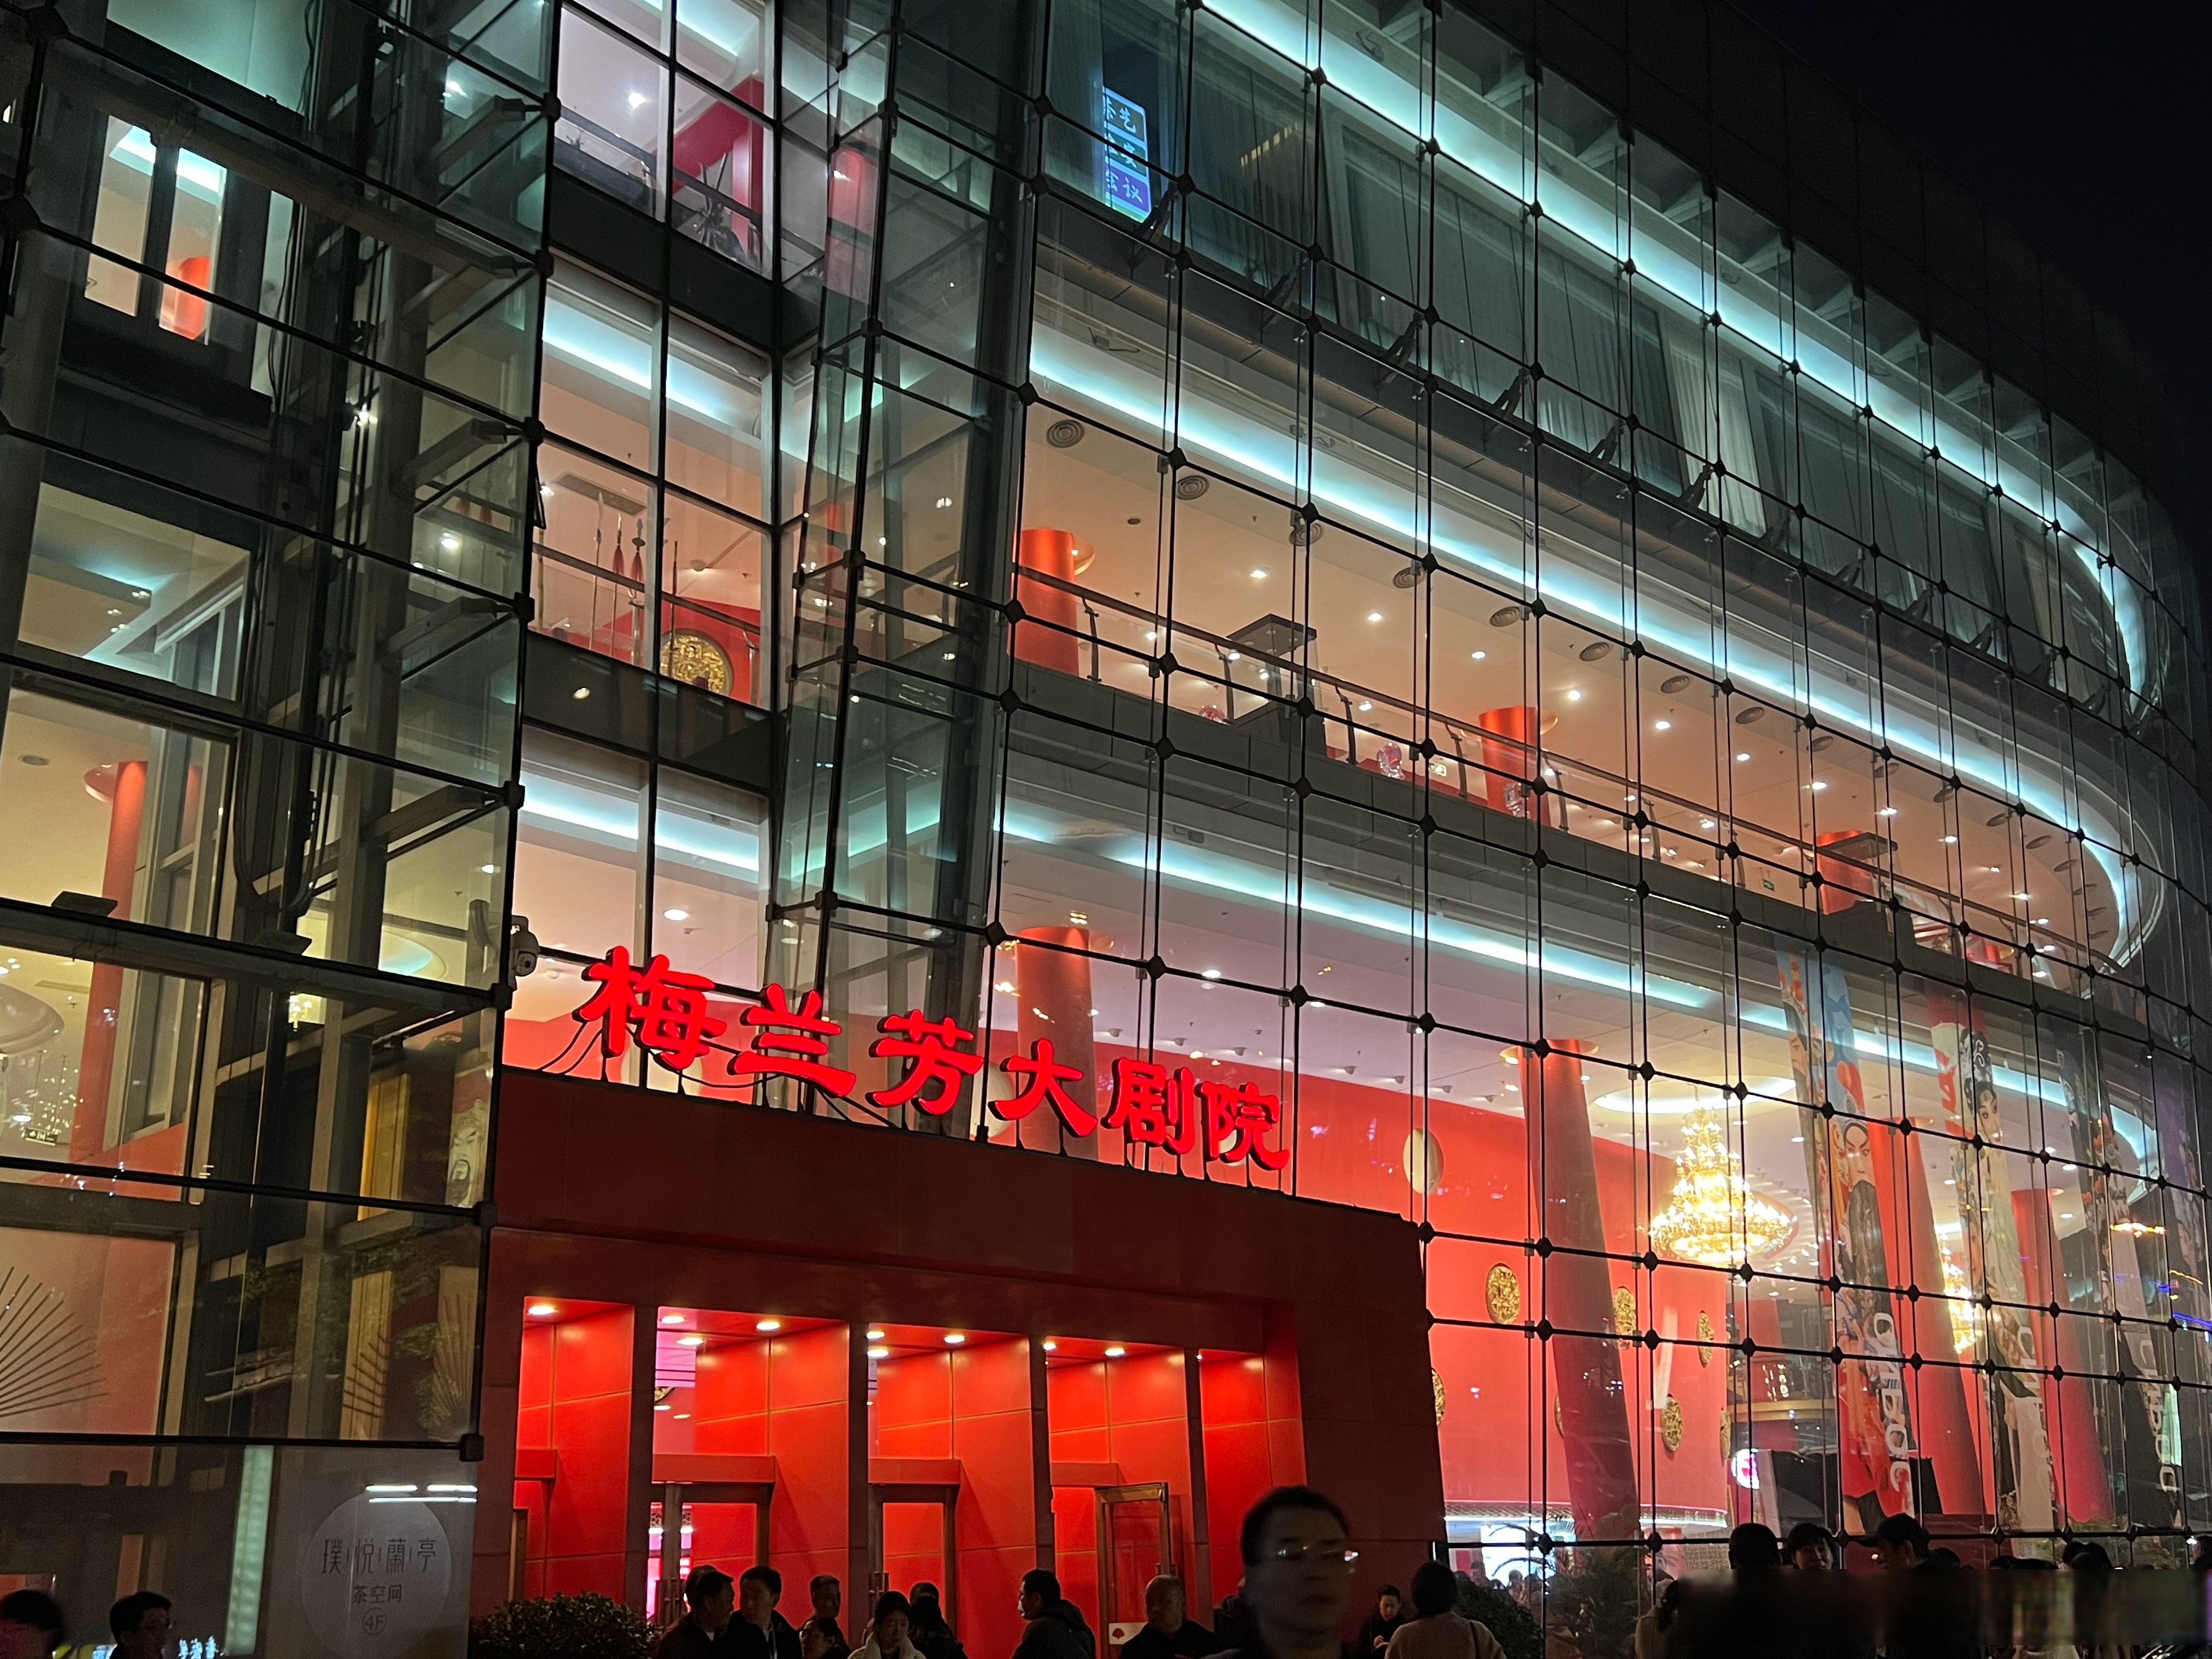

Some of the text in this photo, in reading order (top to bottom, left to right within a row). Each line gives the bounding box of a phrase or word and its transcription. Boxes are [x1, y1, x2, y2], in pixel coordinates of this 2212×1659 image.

[572, 945, 1289, 1170] 梅兰芳大剧院
[352, 1584, 403, 1605] 茶空间
[364, 1615, 384, 1631] 4F
